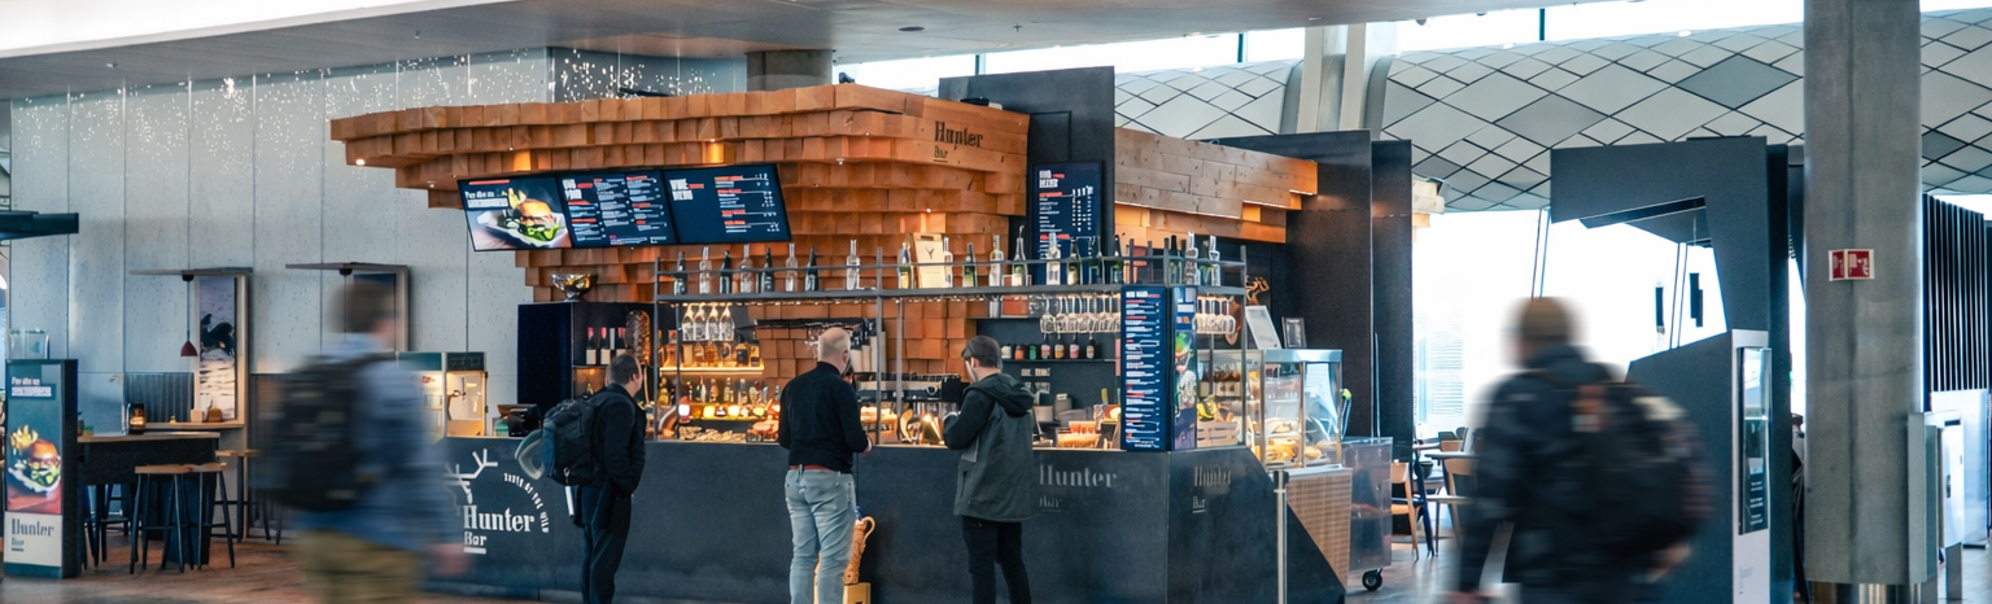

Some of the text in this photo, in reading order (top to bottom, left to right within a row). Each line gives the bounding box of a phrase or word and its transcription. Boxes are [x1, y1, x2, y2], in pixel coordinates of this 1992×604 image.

[935, 121, 984, 148] Hunter
[1040, 464, 1117, 488] Hunter
[12, 518, 54, 537] Hunter
[463, 505, 535, 532] Hunter
[464, 531, 487, 547] Bar
